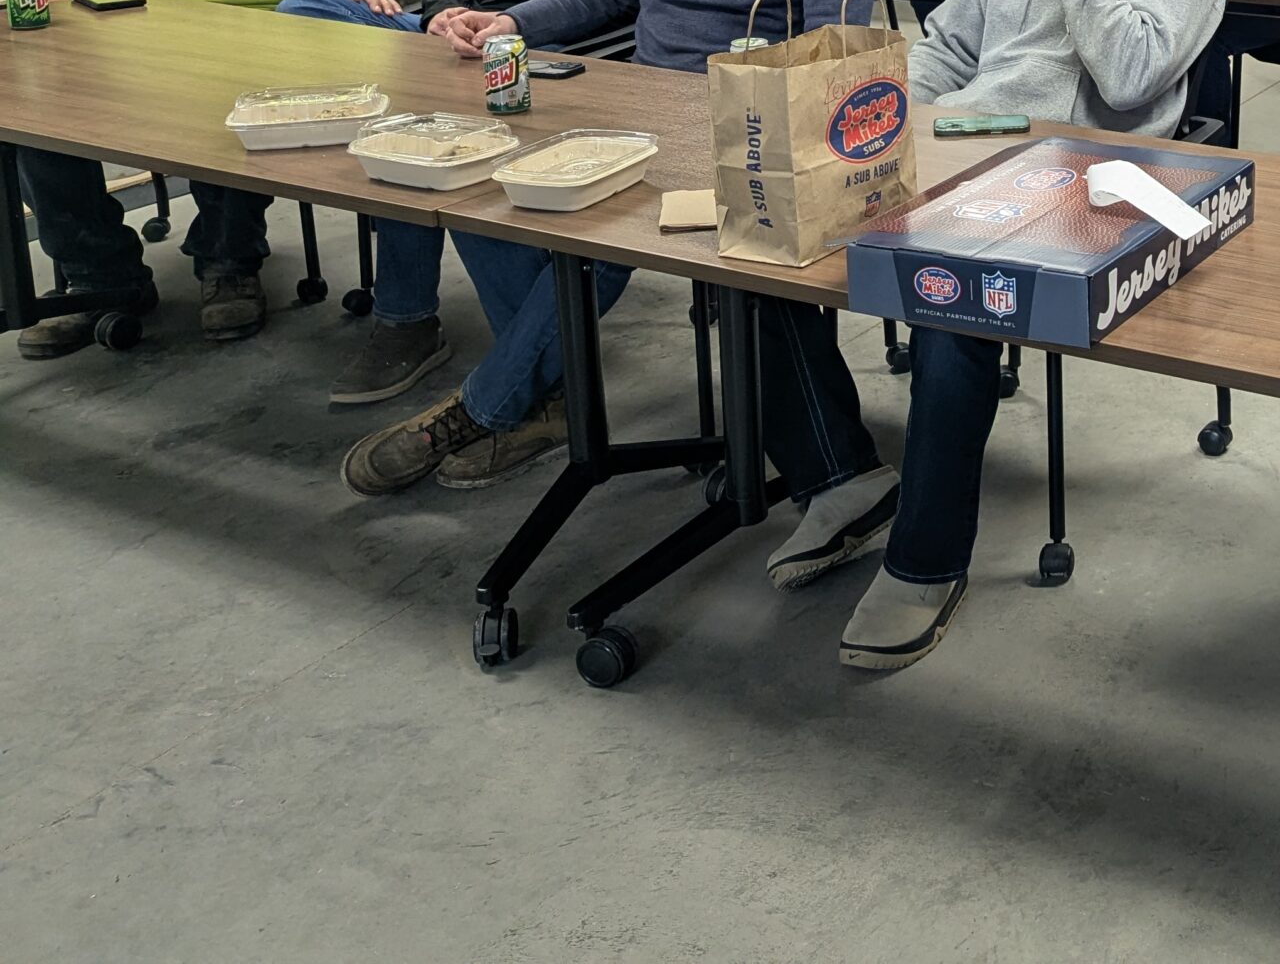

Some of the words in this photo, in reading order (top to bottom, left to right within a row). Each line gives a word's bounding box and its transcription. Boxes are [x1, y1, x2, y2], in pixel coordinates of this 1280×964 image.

[837, 91, 898, 130] Jersey
[746, 113, 763, 174] ABOVE
[863, 138, 886, 155] SUBS
[845, 175, 851, 189] A
[853, 168, 871, 185] SUB
[873, 158, 899, 179] ABOVE
[749, 178, 768, 213] SUB
[758, 217, 774, 229] A
[1220, 214, 1247, 241] CATERING
[919, 272, 955, 289] Jersey
[1097, 237, 1182, 330] Jersey
[987, 290, 1013, 310] NFL
[915, 307, 944, 317] OFFICIAL
[946, 313, 976, 322] PARTNER
